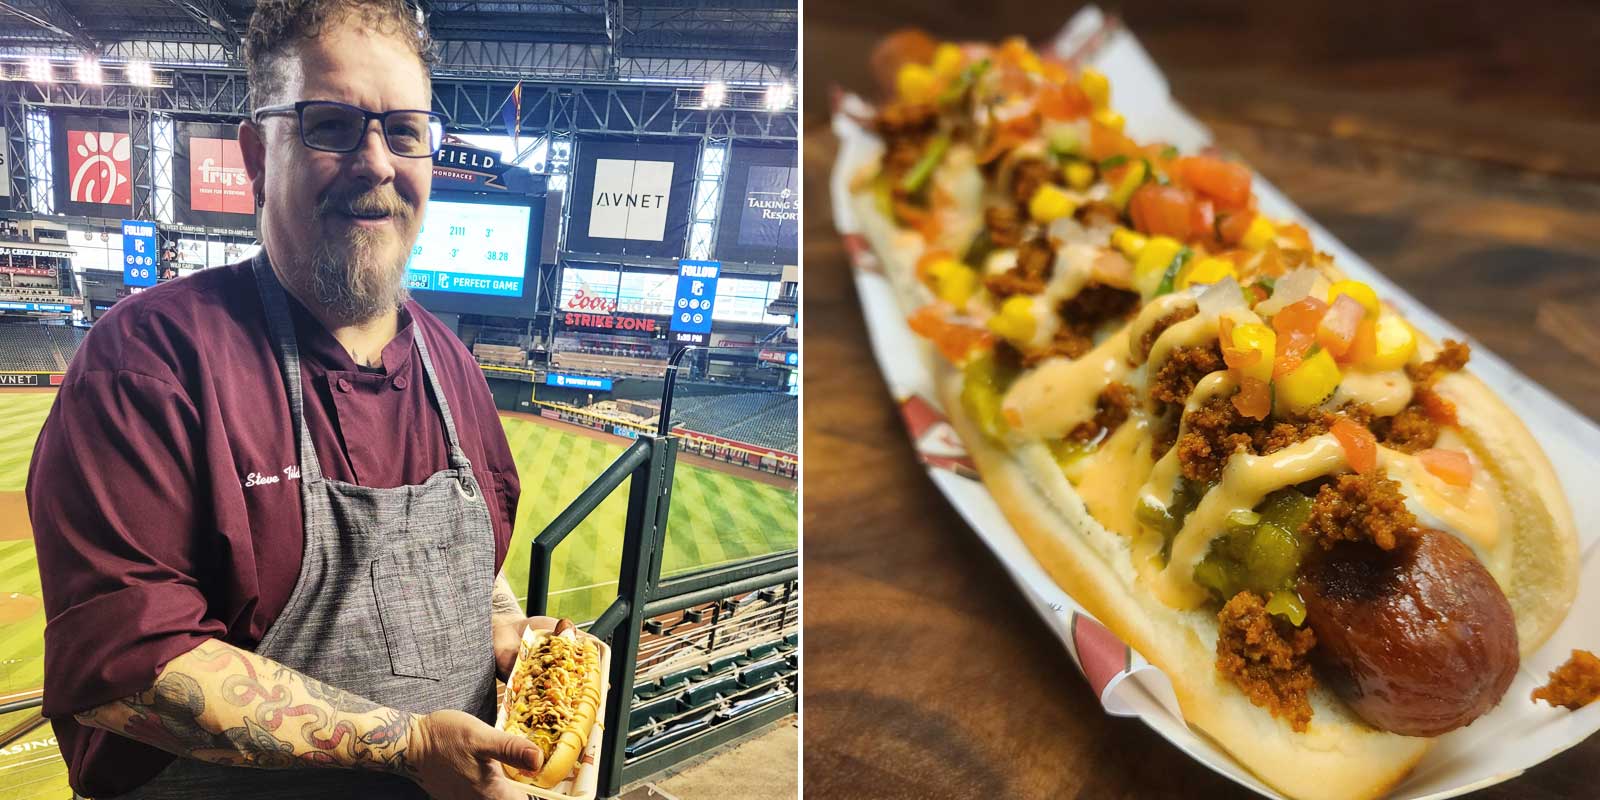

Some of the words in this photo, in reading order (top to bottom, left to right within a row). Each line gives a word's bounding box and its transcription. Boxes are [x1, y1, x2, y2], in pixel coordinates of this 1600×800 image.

[438, 149, 494, 169] FIELD
[198, 158, 247, 187] fry's
[596, 192, 665, 209] AVNET
[124, 225, 153, 237] FOLLOW
[681, 265, 718, 279] FOLLOW
[453, 277, 491, 289] PERFECT
[492, 280, 519, 291] GAME
[568, 289, 617, 312] Coors
[565, 312, 614, 328] STRIKE
[615, 316, 656, 332] ZONE
[245, 472, 279, 487] Steve
